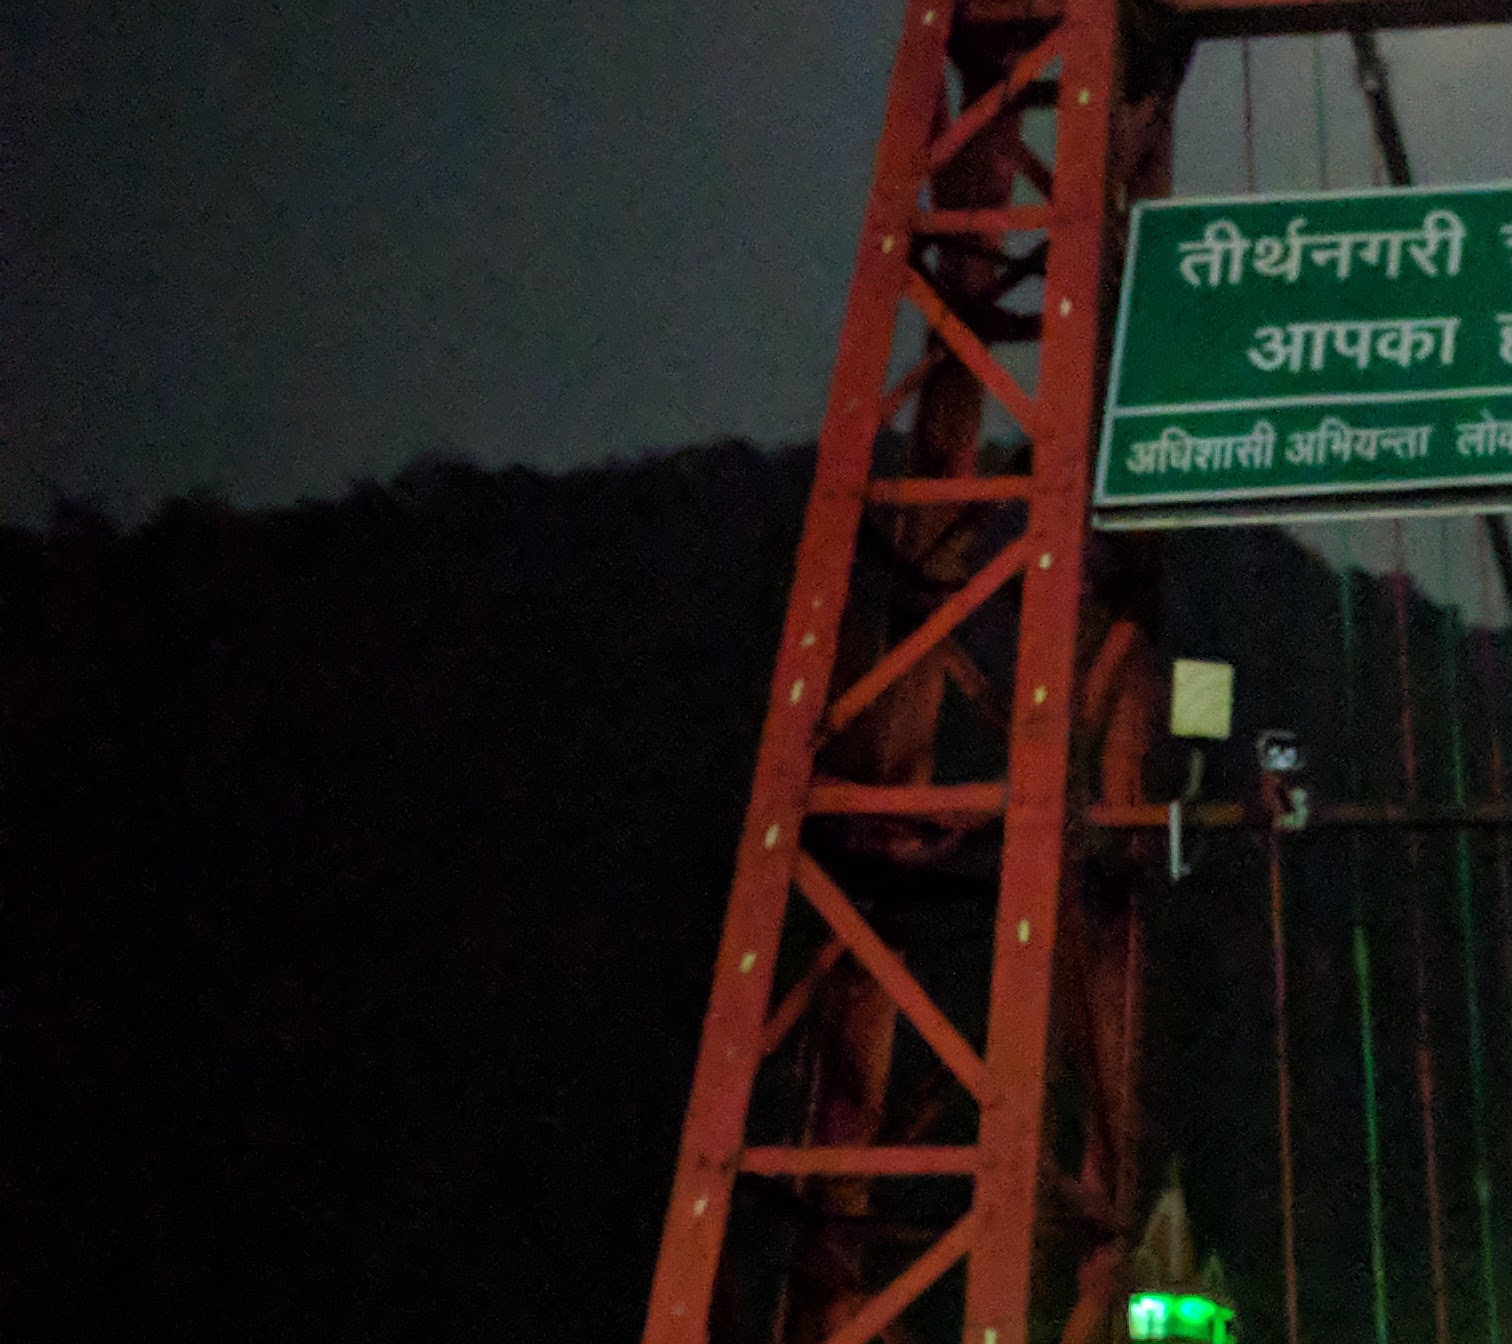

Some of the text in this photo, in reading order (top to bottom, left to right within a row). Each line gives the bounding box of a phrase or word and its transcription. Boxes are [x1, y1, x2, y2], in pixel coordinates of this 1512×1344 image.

[1178, 209, 1465, 286] तीर्थनगरी
[1247, 317, 1460, 372] आपका
[1127, 419, 1274, 473] अधिशासी
[1286, 417, 1430, 465] अभियन्ता
